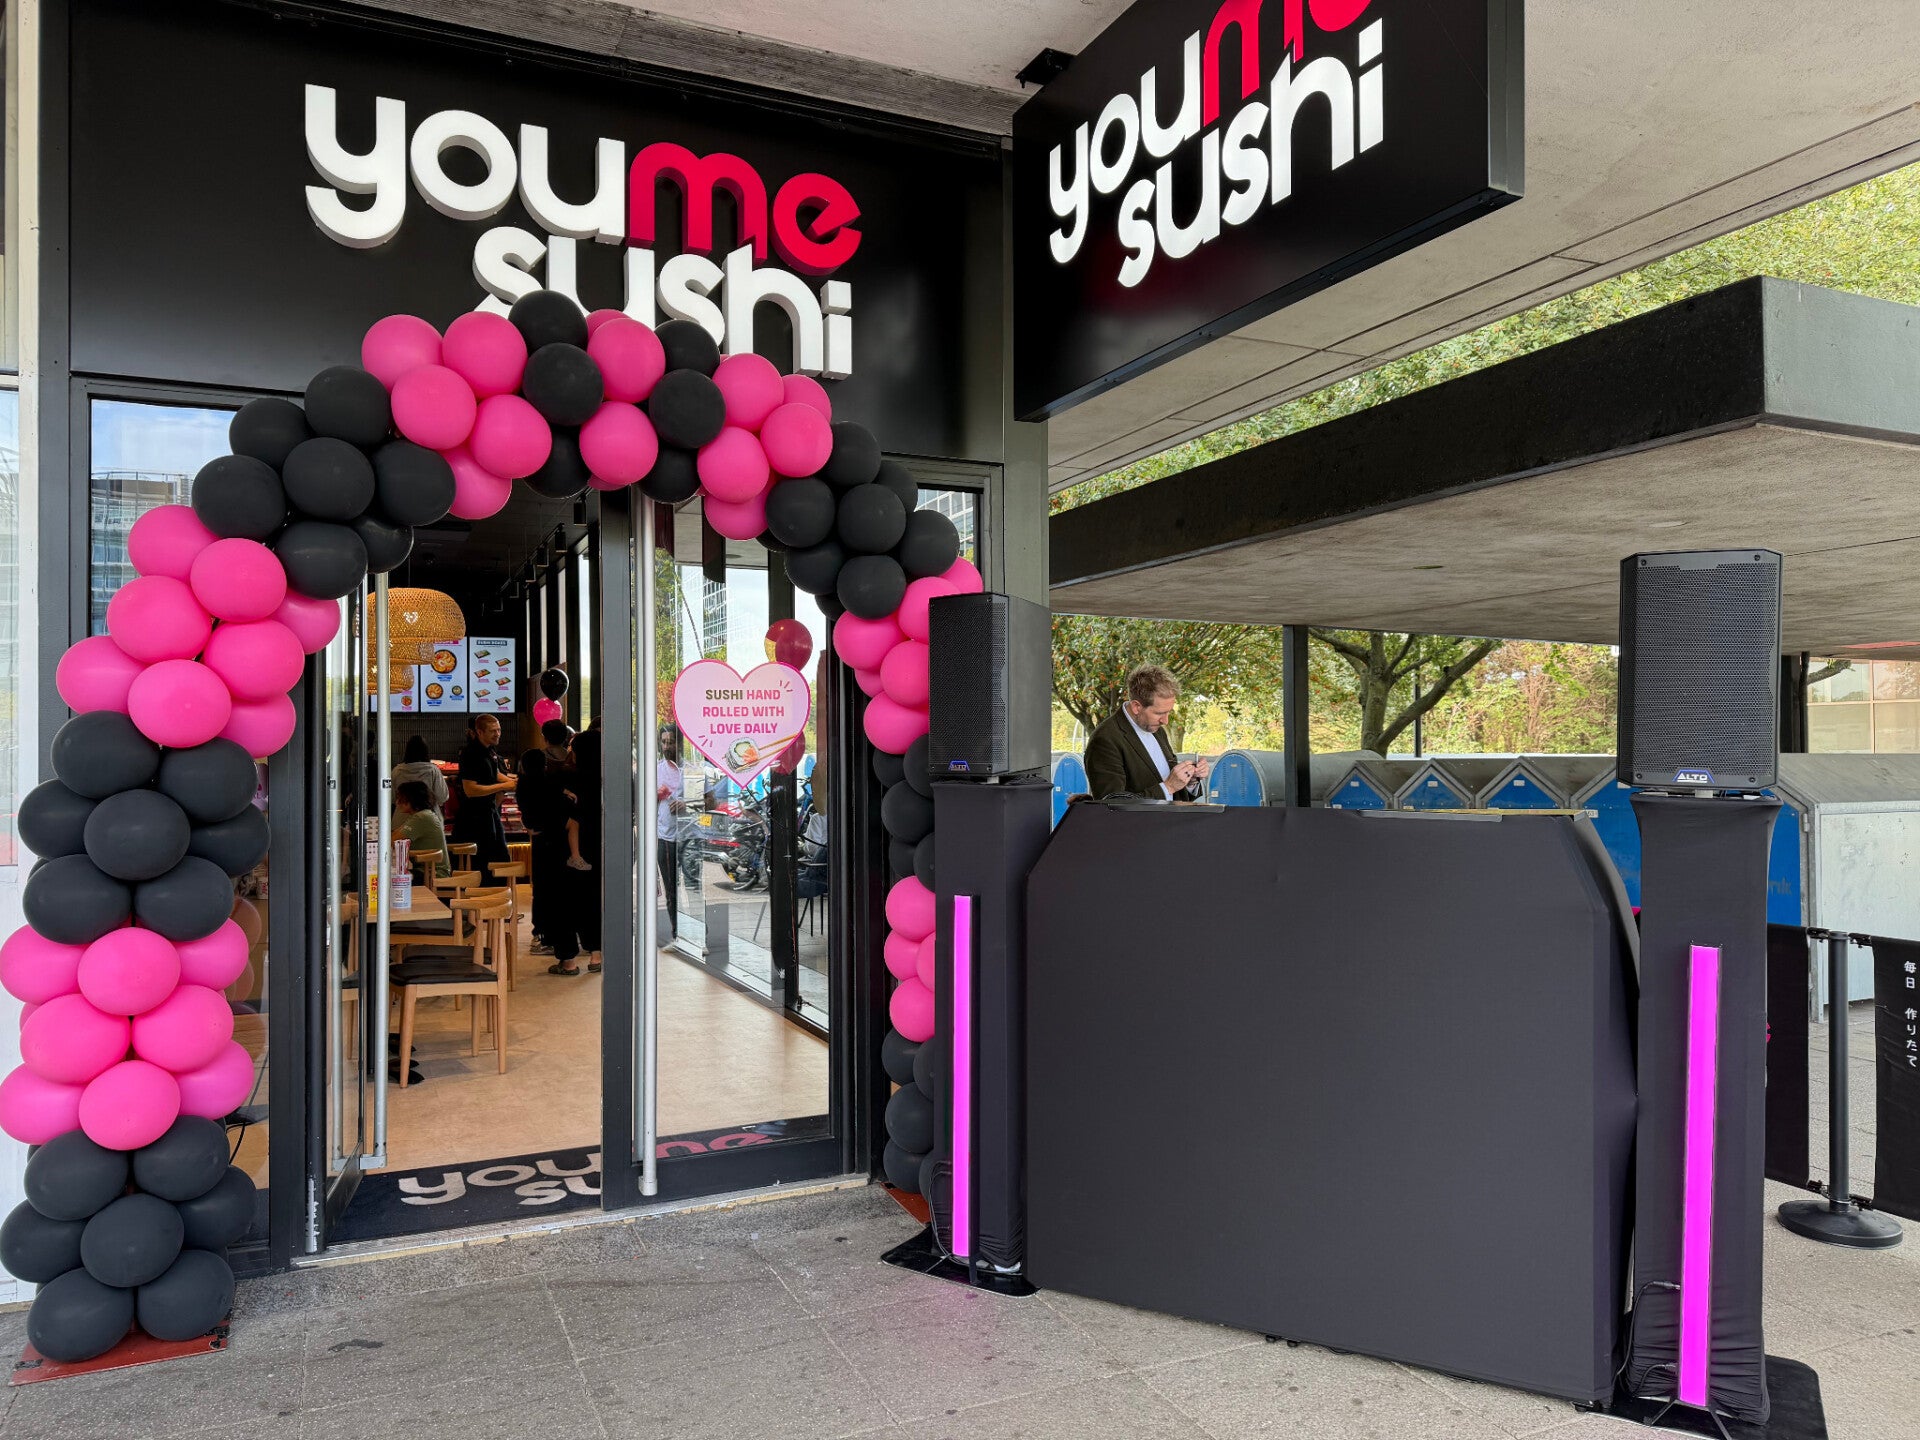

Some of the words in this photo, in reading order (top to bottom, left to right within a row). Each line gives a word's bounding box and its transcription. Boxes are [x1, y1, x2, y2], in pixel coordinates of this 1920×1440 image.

[1117, 18, 1384, 288] sushi
[705, 689, 744, 701] SUSHI
[746, 689, 781, 700] HAND
[702, 706, 749, 717] ROLLED
[752, 706, 785, 717] WITH
[710, 723, 741, 734] LOVE
[744, 722, 778, 734] DAILY
